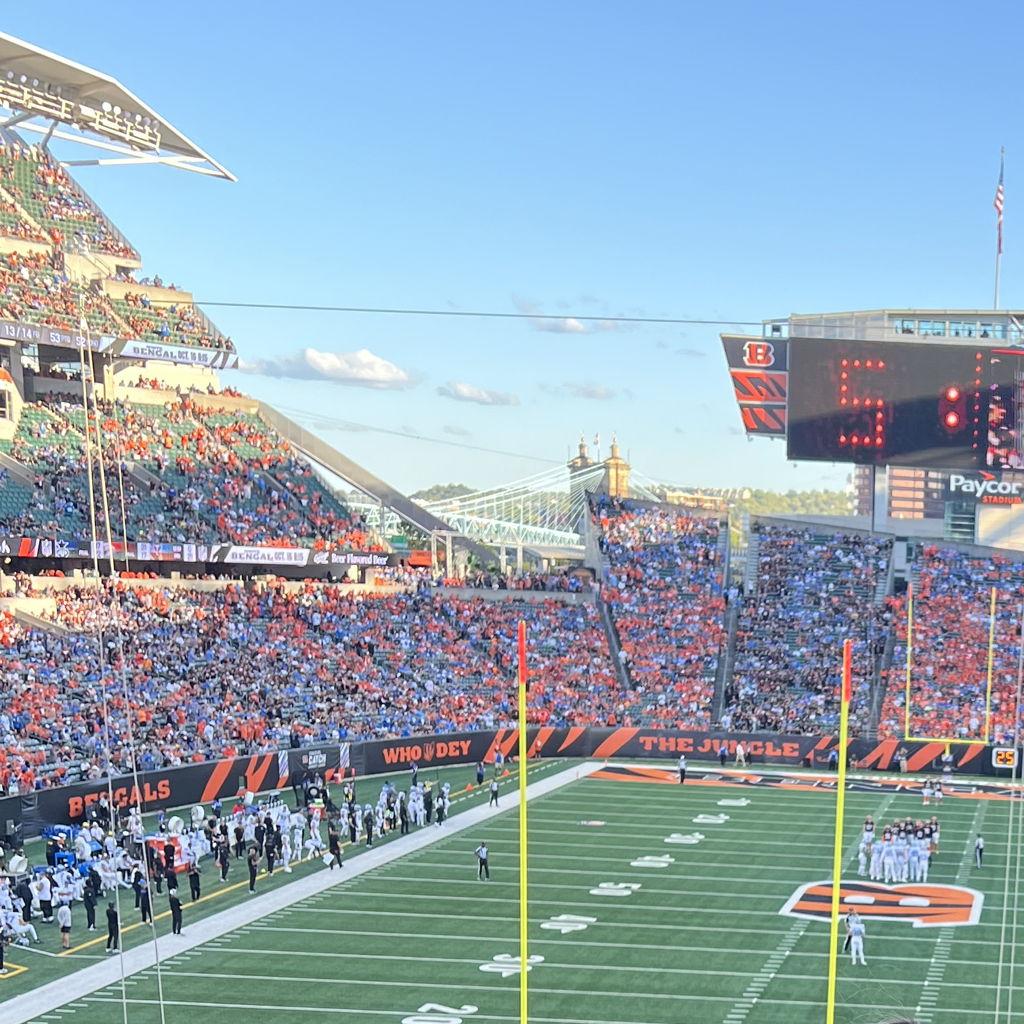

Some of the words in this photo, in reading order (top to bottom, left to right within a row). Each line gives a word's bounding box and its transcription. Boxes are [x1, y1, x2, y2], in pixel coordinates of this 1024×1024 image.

[50, 332, 60, 342] 53
[950, 474, 1023, 498] Paycor
[982, 495, 1024, 505] STADIUM
[382, 745, 422, 764] WHO
[435, 740, 472, 758] DEY
[639, 737, 694, 752] THE
[996, 751, 1014, 766] 25
